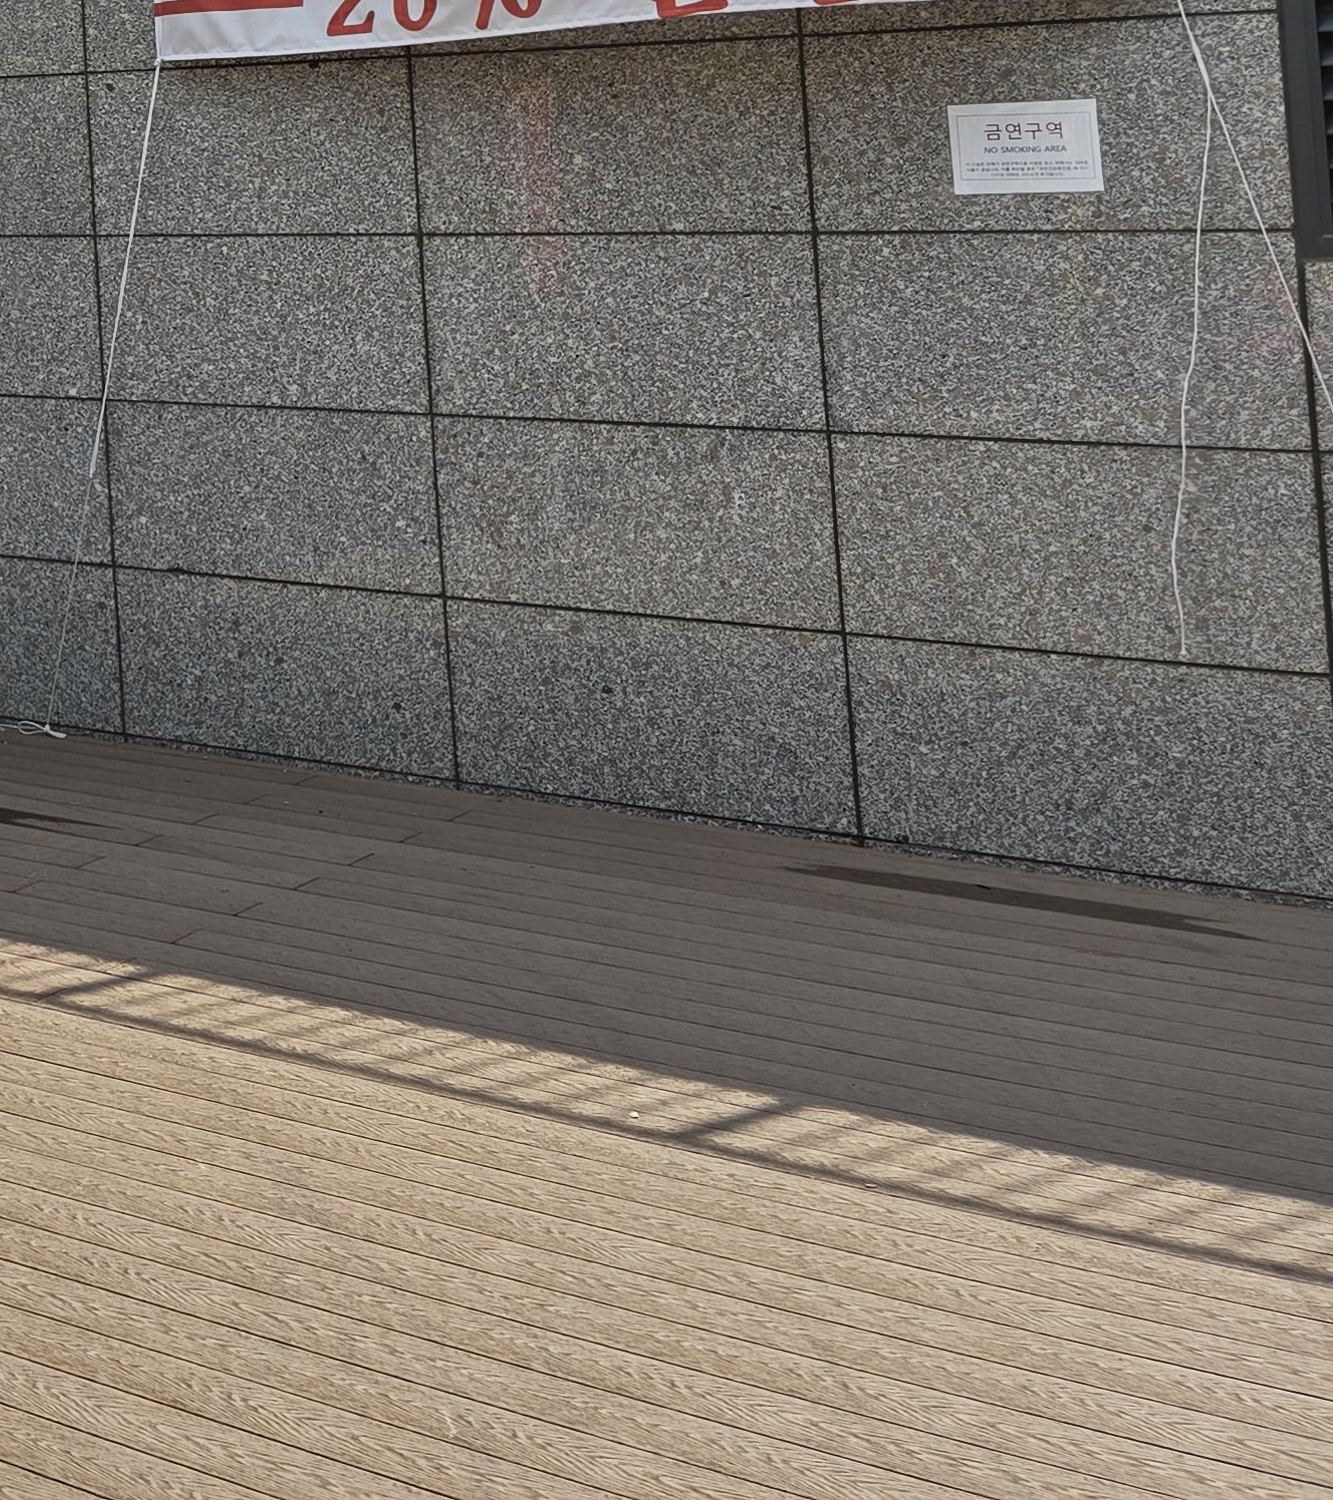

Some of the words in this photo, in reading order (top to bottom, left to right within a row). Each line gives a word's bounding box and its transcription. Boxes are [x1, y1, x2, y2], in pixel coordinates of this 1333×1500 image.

[983, 121, 1064, 141] 금연구역
[984, 146, 999, 154] NO
[1001, 145, 1042, 154] SMOKING
[1044, 144, 1068, 153] AREA
